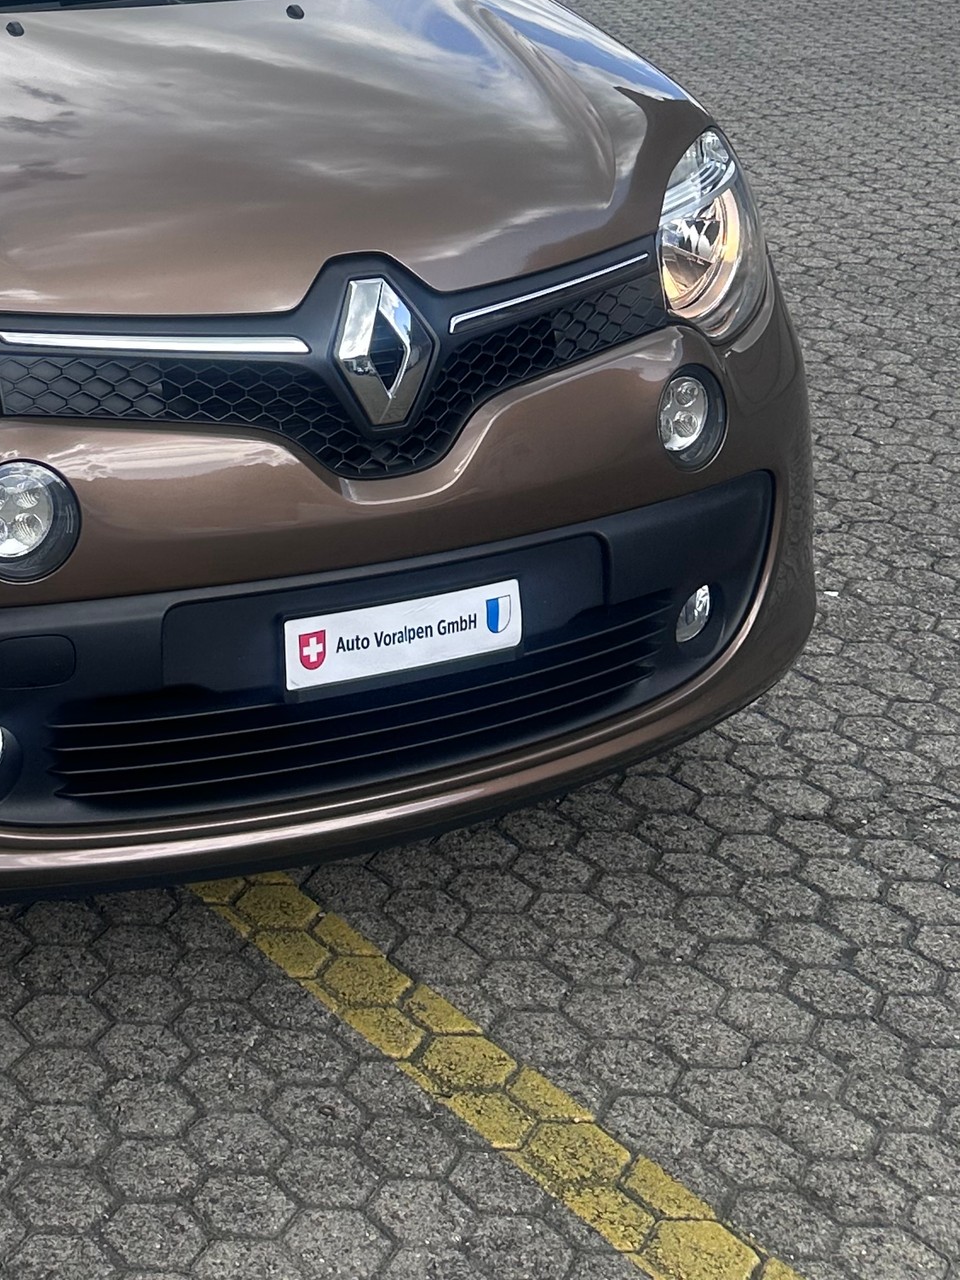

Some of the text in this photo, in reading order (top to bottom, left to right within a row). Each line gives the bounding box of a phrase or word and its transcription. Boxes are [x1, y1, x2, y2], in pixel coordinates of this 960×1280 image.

[336, 613, 477, 654] Auto Voralpen GmbH
